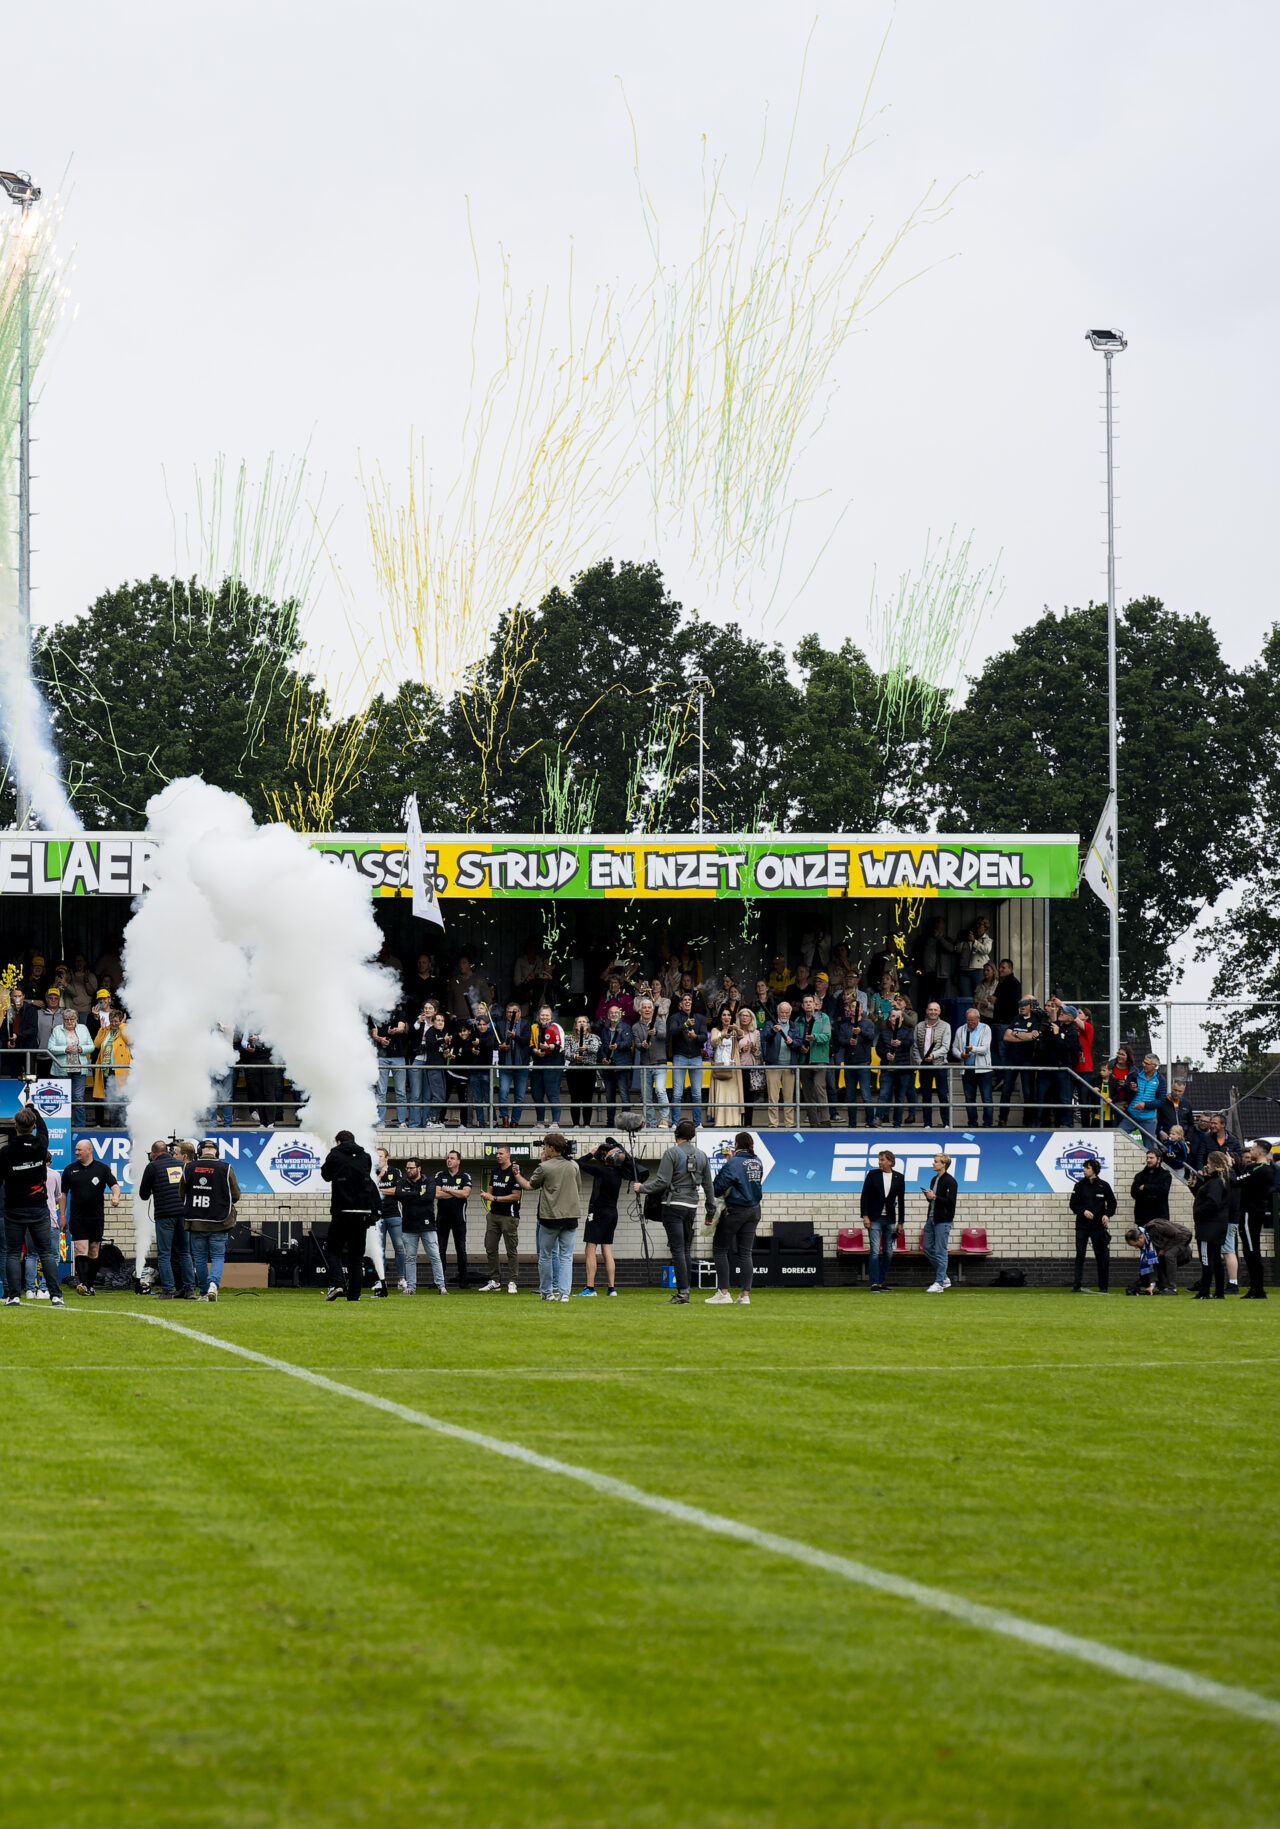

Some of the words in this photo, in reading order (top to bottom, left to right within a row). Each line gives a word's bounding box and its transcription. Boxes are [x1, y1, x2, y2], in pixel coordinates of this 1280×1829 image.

[456, 847, 579, 892] STRIJD
[589, 850, 635, 889] EN
[644, 850, 747, 890] INZET
[754, 850, 850, 890] ONZE
[859, 848, 1033, 890] WAARDEN.
[830, 1143, 981, 1182] ESPN
[192, 1195, 210, 1208] HB
